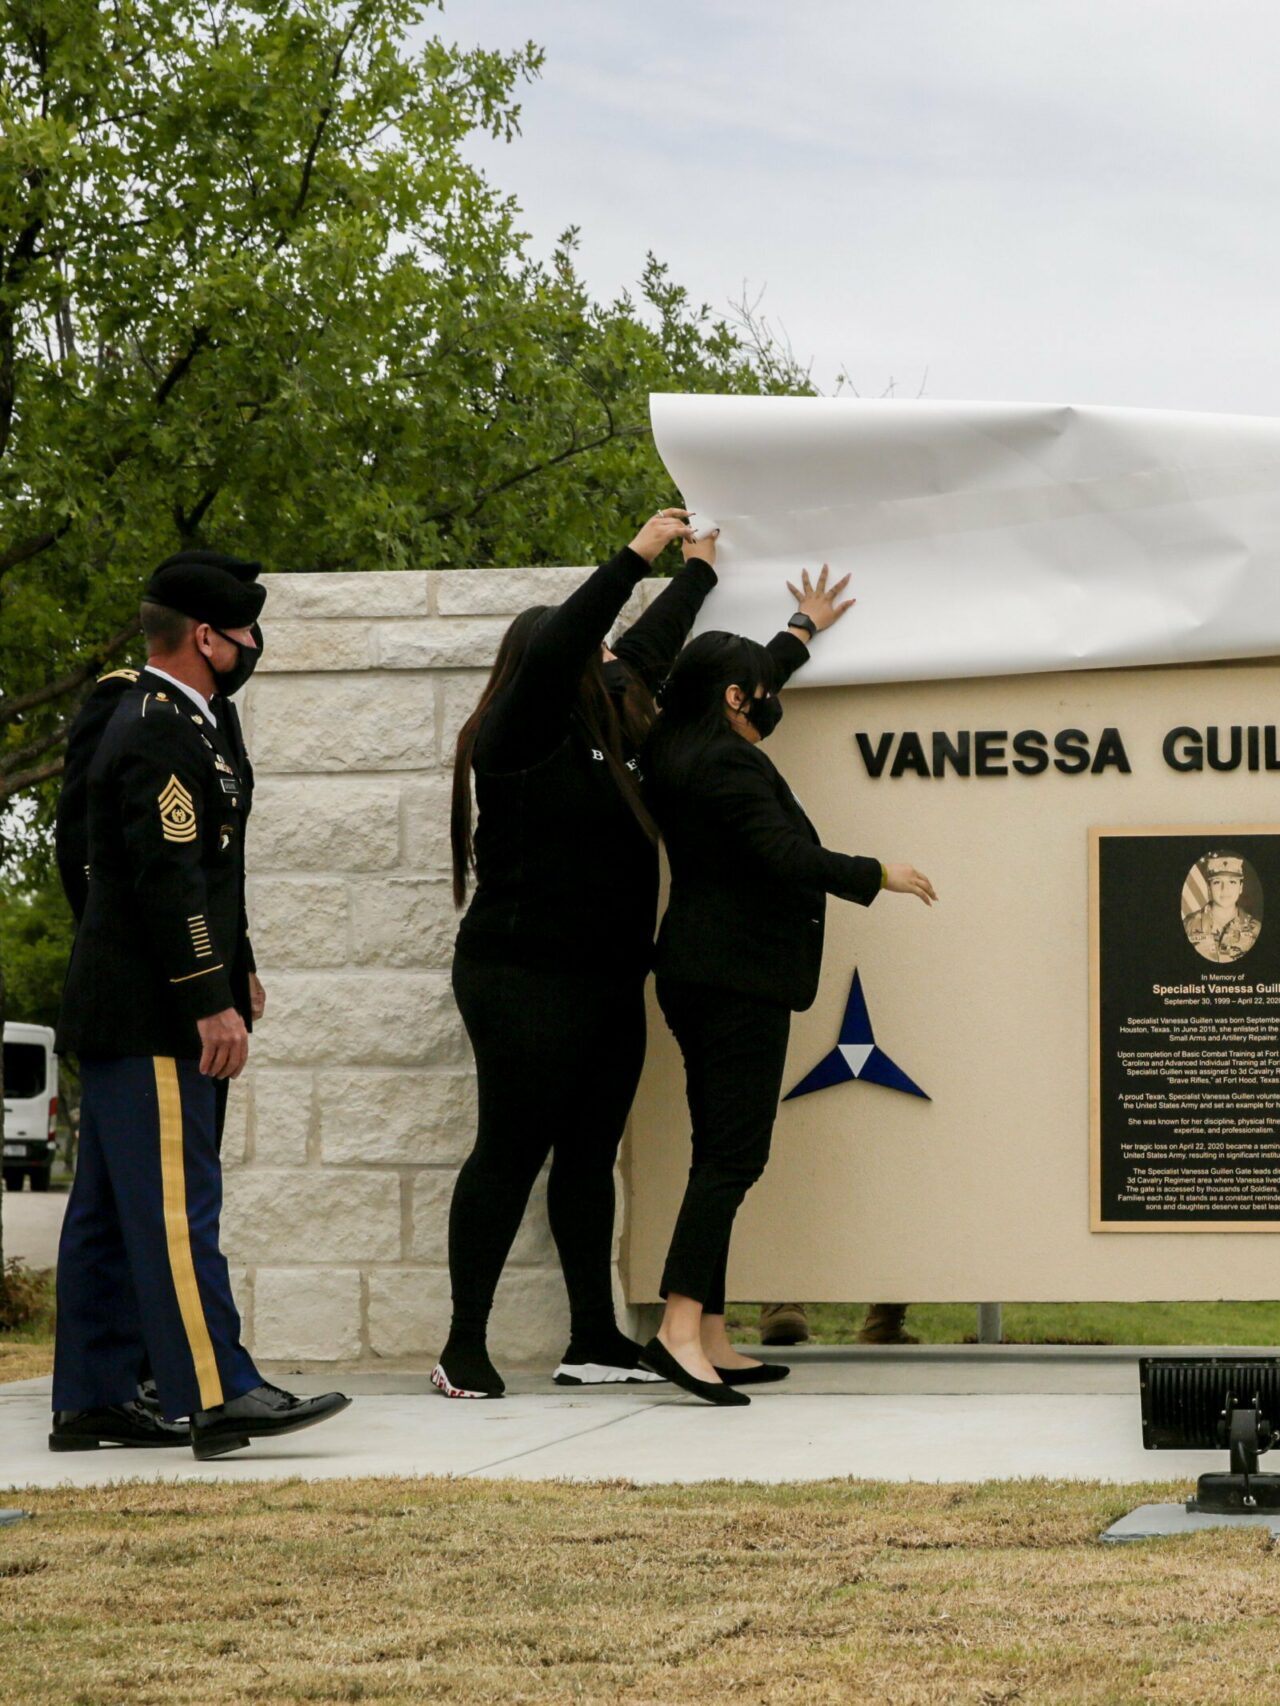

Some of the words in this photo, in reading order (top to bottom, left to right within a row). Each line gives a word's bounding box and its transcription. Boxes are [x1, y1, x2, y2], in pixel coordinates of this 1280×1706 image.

[855, 728, 1132, 778] VANESSA
[1201, 973, 1207, 981] In
[1209, 973, 1236, 982] Memory
[1238, 973, 1244, 981] of
[1153, 983, 1205, 996] Specialist
[1208, 983, 1253, 994] Vanessa
[1164, 997, 1200, 1006] September
[1202, 997, 1213, 1006] 30,
[1214, 997, 1230, 1005] 1999
[1237, 997, 1252, 1006] April
[1254, 996, 1265, 1005] 22,
[1128, 1017, 1159, 1026] Specialist
[1160, 1017, 1188, 1025] Vanessa
[1190, 1016, 1213, 1025] Guillen
[1229, 1016, 1244, 1024] born
[1182, 1025, 1197, 1033] June
[1220, 1025, 1231, 1033] she
[1233, 1025, 1259, 1033] enlisted
[1268, 1025, 1278, 1033] the
[1169, 1034, 1188, 1042] Small
[1189, 1034, 1206, 1042] Arms
[1208, 1034, 1220, 1042] and
[1222, 1034, 1247, 1043] Artillery
[1117, 1050, 1135, 1059] Upon
[1137, 1050, 1172, 1059] completion
[1182, 1050, 1200, 1058] Basic
[1202, 1050, 1227, 1058] Combat
[1229, 1049, 1255, 1059] Training
[1265, 1049, 1279, 1058] Fort
[1122, 1059, 1149, 1067] Carolina
[1151, 1059, 1163, 1067] and
[1165, 1059, 1197, 1067] Advanced
[1199, 1059, 1230, 1067] Individual
[1232, 1058, 1258, 1068] Training
[1127, 1068, 1158, 1077] Specialist
[1160, 1067, 1182, 1076] Guillen
[1199, 1068, 1228, 1077] assigned
[1249, 1067, 1274, 1077] Cavalry
[1223, 1076, 1237, 1084] Fort
[1125, 1092, 1143, 1102] proud
[1169, 1092, 1200, 1102] Specialist
[1202, 1092, 1230, 1100] Vanessa
[1232, 1092, 1254, 1100] Guillen
[1136, 1101, 1157, 1110] United
[1159, 1101, 1179, 1109] States
[1181, 1101, 1198, 1110] Army
[1200, 1101, 1212, 1109] and
[1214, 1101, 1224, 1109] set
[1236, 1101, 1263, 1110] example
[1265, 1101, 1274, 1109] for
[1128, 1117, 1141, 1126] She
[1181, 1117, 1189, 1125] for
[1238, 1117, 1264, 1126] physical
[1208, 1126, 1220, 1134] and
[1135, 1143, 1152, 1152] tragic
[1179, 1142, 1194, 1151] April
[1208, 1142, 1224, 1150] 2020
[1124, 1151, 1144, 1159] United
[1147, 1151, 1167, 1159] States
[1189, 1151, 1217, 1160] resulting
[1227, 1151, 1259, 1160] significant
[1133, 1167, 1146, 1175] The
[1148, 1167, 1179, 1177] Specialist
[1211, 1167, 1233, 1175] Guillen
[1235, 1167, 1251, 1175] Gate
[1253, 1167, 1271, 1175] leads
[1137, 1176, 1162, 1185] Cavalry
[1164, 1176, 1195, 1186] Regiment
[1214, 1176, 1234, 1184] where
[1236, 1176, 1264, 1184] Vanessa
[1266, 1176, 1280, 1184] lived
[1126, 1185, 1138, 1193] The
[1140, 1185, 1155, 1194] gate
[1164, 1185, 1195, 1193] accessed
[1206, 1185, 1240, 1193] thousands
[1118, 1193, 1145, 1202] Families
[1147, 1194, 1163, 1202] each
[1186, 1194, 1207, 1202] stands
[1225, 1194, 1253, 1202] constant
[1177, 1203, 1210, 1212] daughters
[1212, 1203, 1238, 1211] deserve
